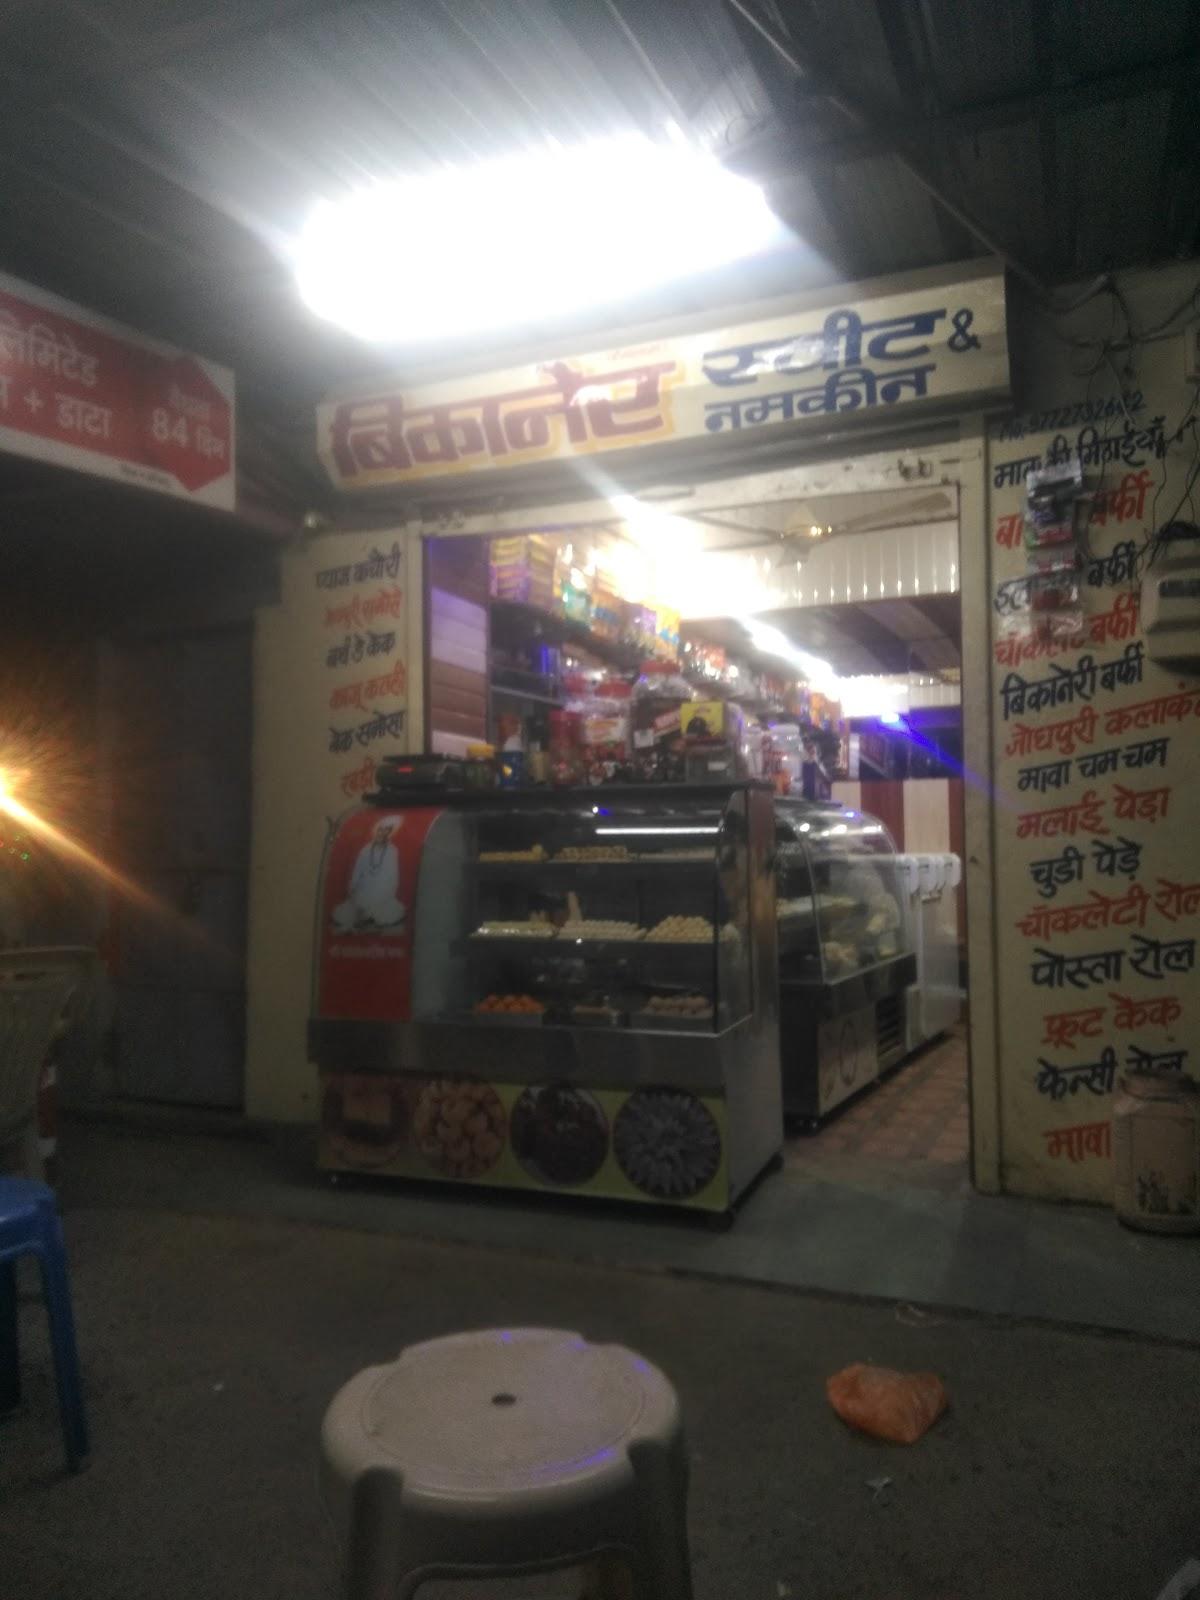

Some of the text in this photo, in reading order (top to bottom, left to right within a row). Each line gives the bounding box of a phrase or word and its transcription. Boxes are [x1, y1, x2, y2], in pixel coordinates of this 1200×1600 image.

[330, 308, 981, 479] बिकानेर स्वीट &
[704, 363, 937, 434] नमकीन
[152, 407, 188, 448] 84
[1088, 539, 1137, 589] बर्फी
[1087, 591, 1141, 646] बर्फी
[1001, 641, 1146, 720] बिकानेरी बर्फी
[1017, 736, 1172, 794] मावा चम चम
[1015, 789, 1112, 840] मलाई
[1129, 932, 1197, 981] रोल
[1108, 990, 1183, 1032] केक
[1041, 1120, 1113, 1164] मावा
